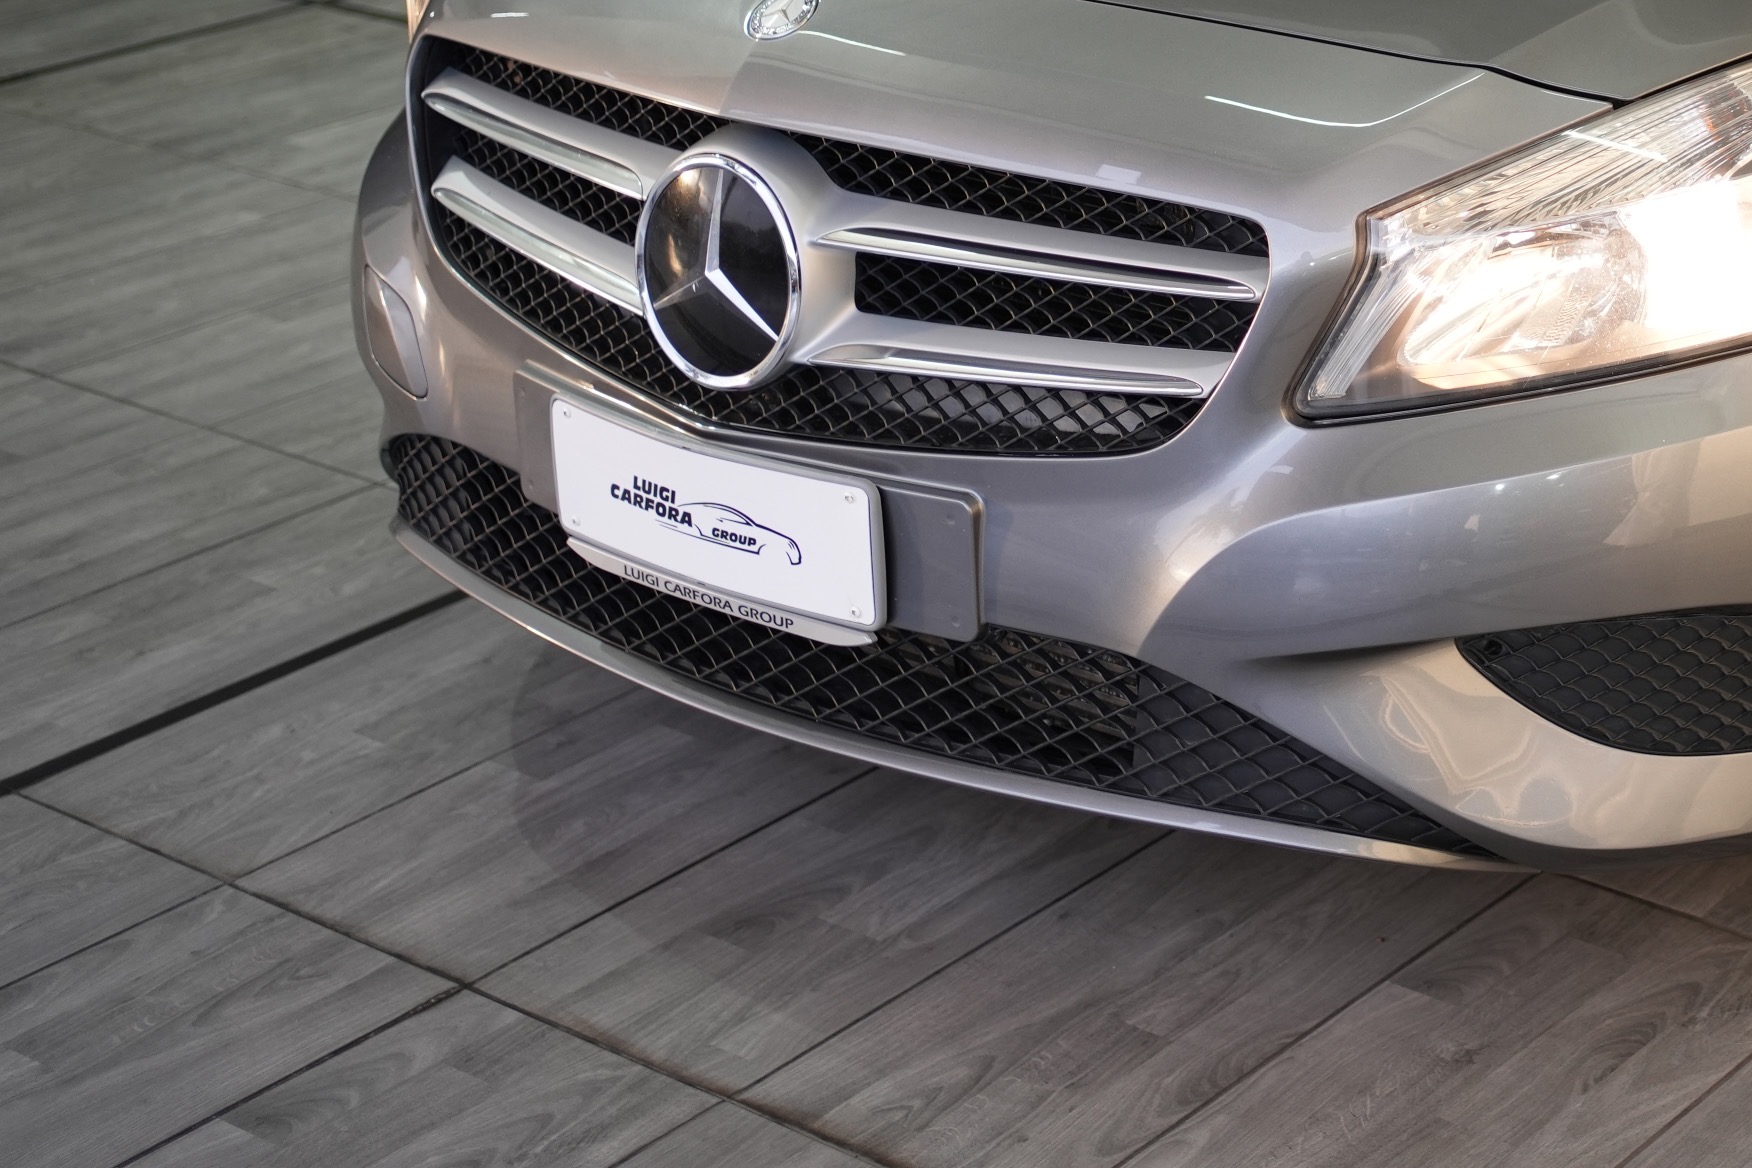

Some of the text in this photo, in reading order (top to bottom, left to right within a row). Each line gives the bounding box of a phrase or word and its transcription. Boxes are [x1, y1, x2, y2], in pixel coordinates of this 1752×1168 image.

[610, 483, 693, 527] CARFORA
[633, 475, 676, 504] LUIGI
[711, 527, 757, 547] GROUP
[624, 565, 794, 629] LUIGI CARFORA GROUP
